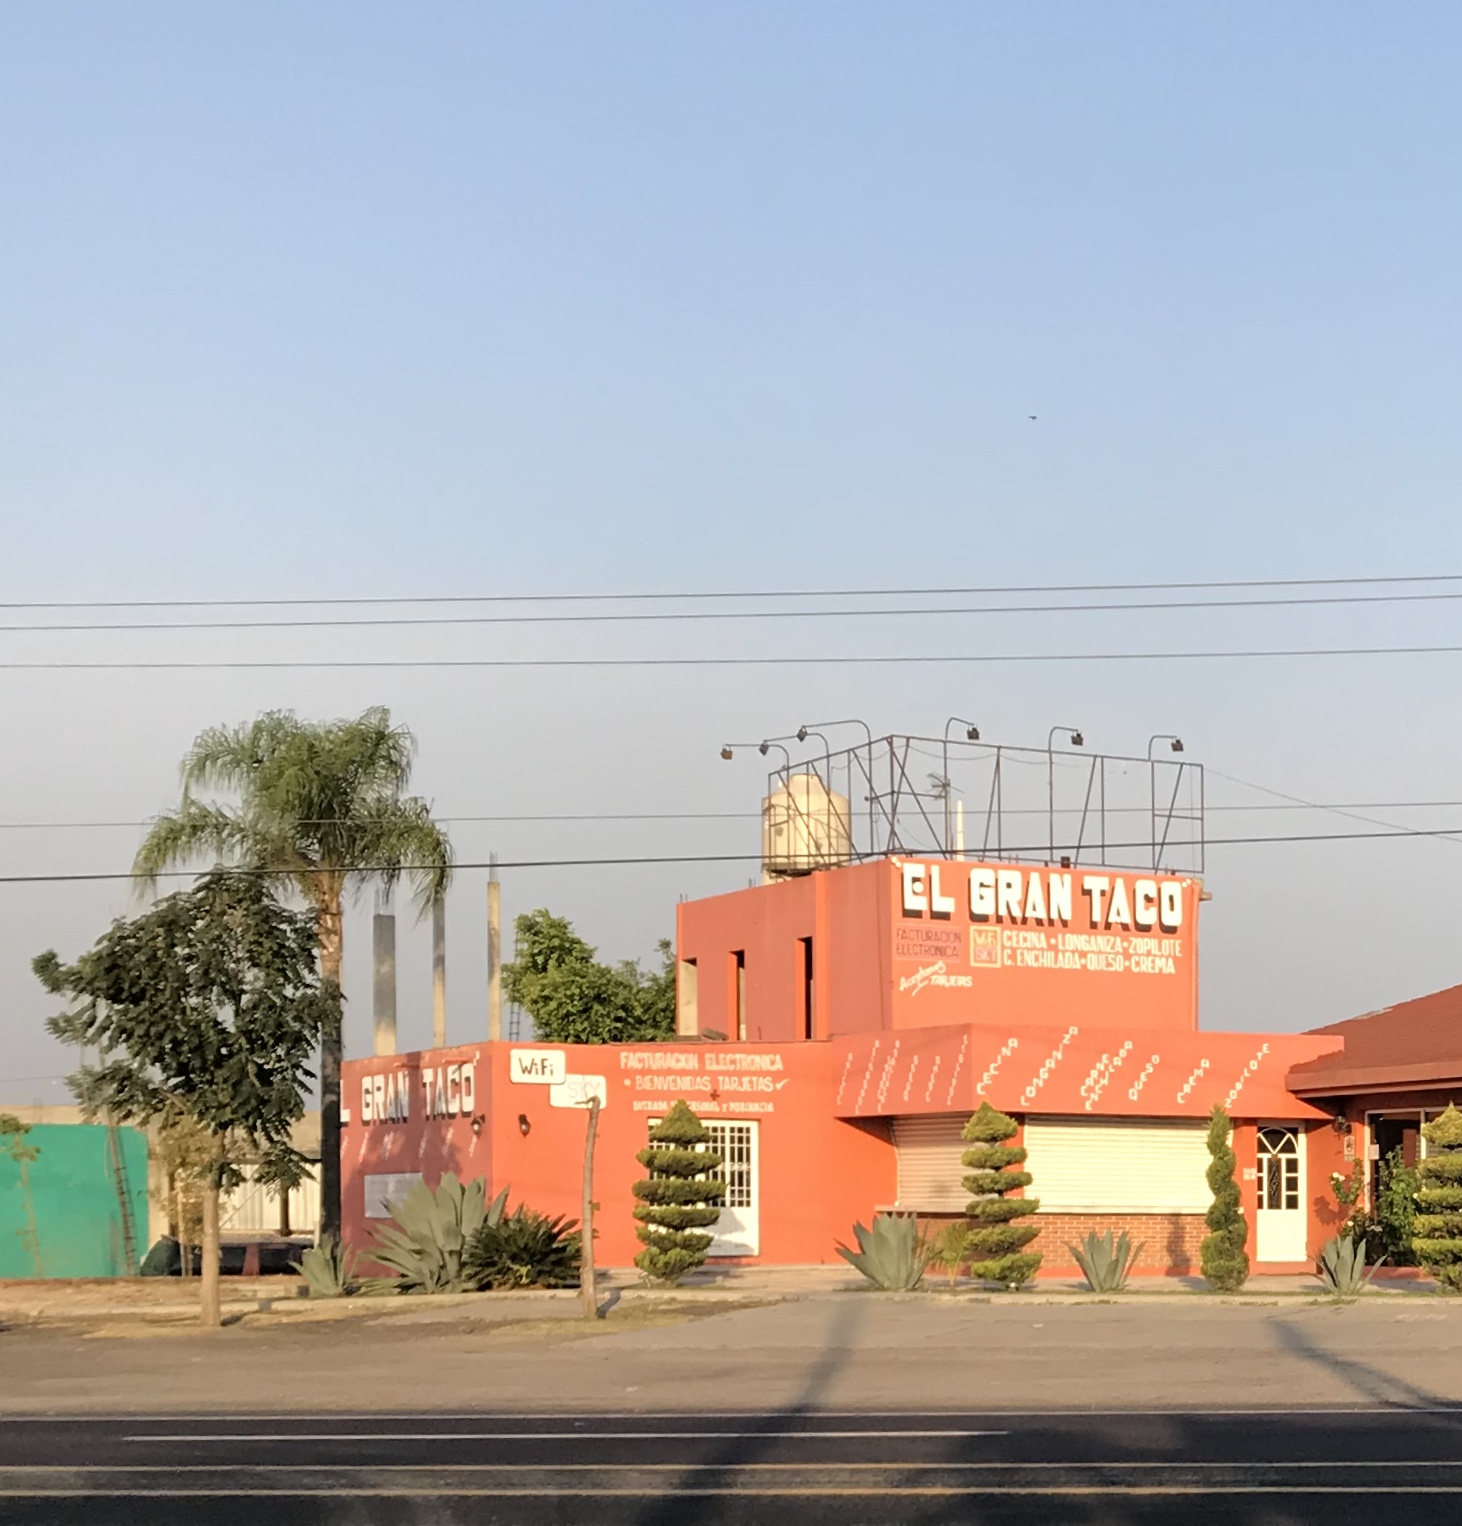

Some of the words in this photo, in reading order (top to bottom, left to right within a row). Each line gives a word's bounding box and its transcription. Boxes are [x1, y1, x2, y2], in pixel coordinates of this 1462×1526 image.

[901, 863, 955, 920] EL
[969, 868, 1072, 928] GRAN
[1082, 876, 1183, 934] TACO
[1003, 930, 1047, 948] CECINA
[1058, 934, 1123, 953] LONGANIZA
[1129, 937, 1182, 957] ZOPILOTE
[1017, 950, 1081, 970] ENCHILADA
[1087, 953, 1124, 972] QUESO
[1131, 956, 1176, 974] CREMA
[518, 1057, 555, 1077] WiFi
[620, 1052, 698, 1070] FACTURACION
[705, 1053, 783, 1071] ELECTRONICA
[635, 1075, 711, 1091] BIENVENIDAS
[717, 1076, 774, 1092] TARJETAS
[977, 1038, 1018, 1095] CECINA
[1020, 1026, 1079, 1106] LONGANIZA
[1081, 1053, 1110, 1096] CARNE
[1085, 1041, 1132, 1110] ENCHILADA
[1128, 1055, 1160, 1101] QUESO
[1177, 1059, 1210, 1104] CREMA
[1224, 1043, 1270, 1109] ZOPILOTE
[361, 1073, 410, 1124] GRAN
[423, 1063, 475, 1120] TACO
